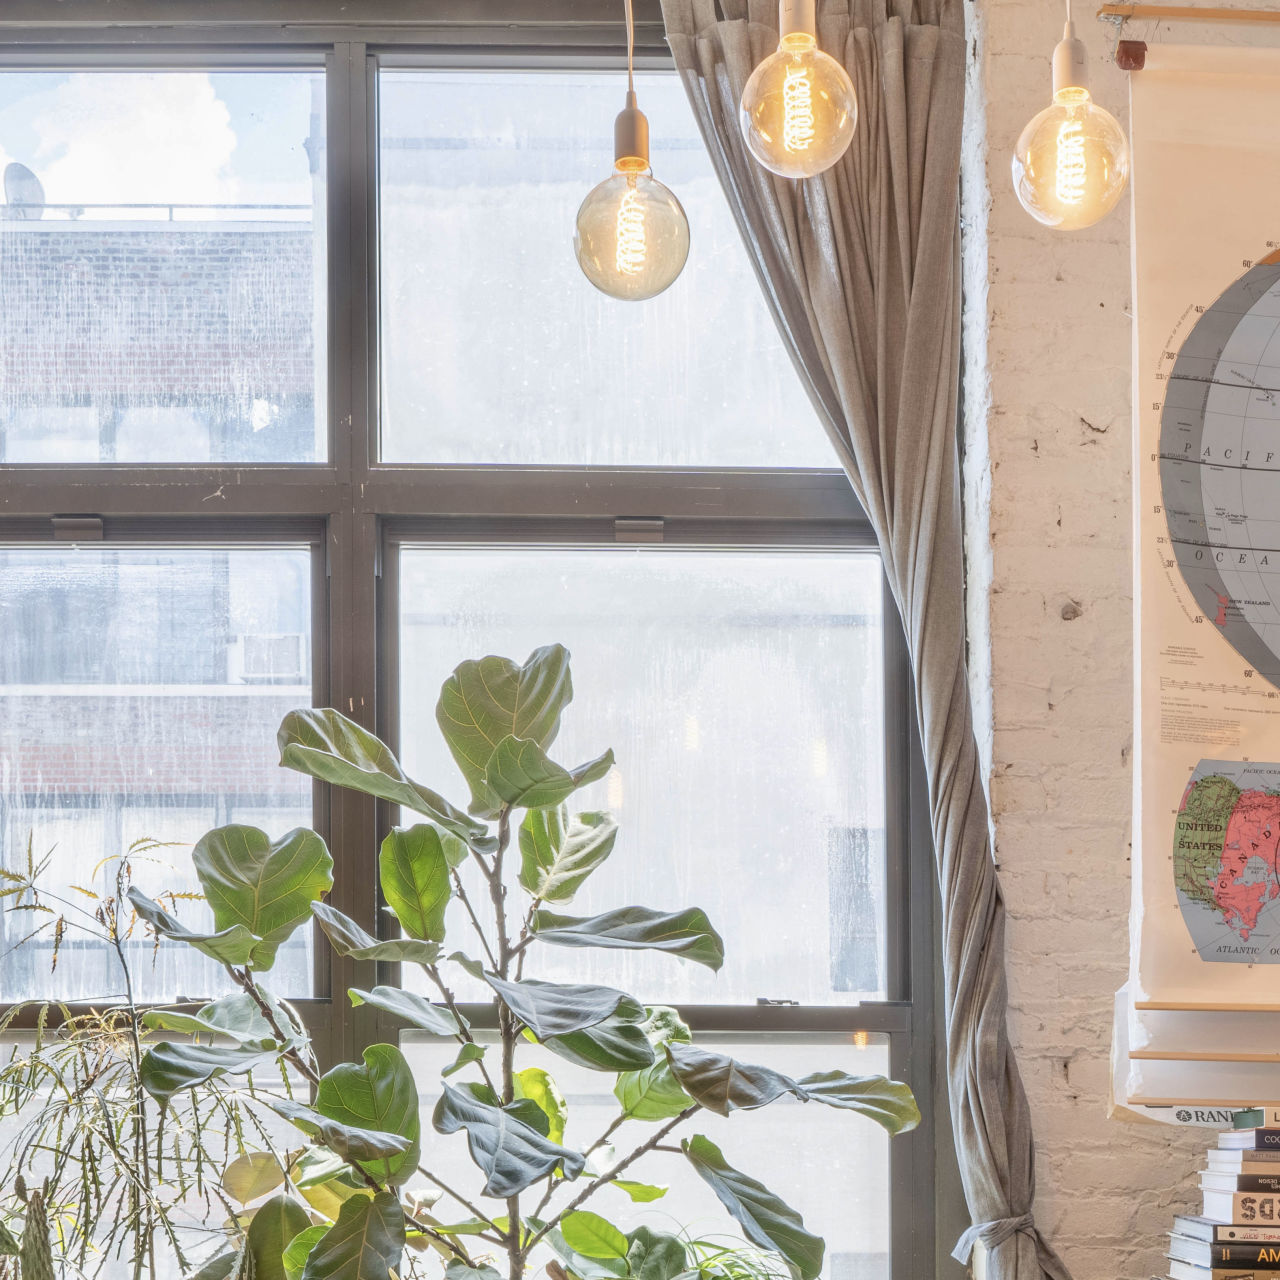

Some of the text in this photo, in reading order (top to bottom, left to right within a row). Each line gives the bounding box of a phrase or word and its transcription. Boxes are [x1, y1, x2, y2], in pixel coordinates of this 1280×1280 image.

[1178, 823, 1222, 832] UNITED
[1178, 841, 1222, 851] STATES
[1216, 946, 1260, 955] ATLANTIC
[1195, 1110, 1235, 1123] RAN
